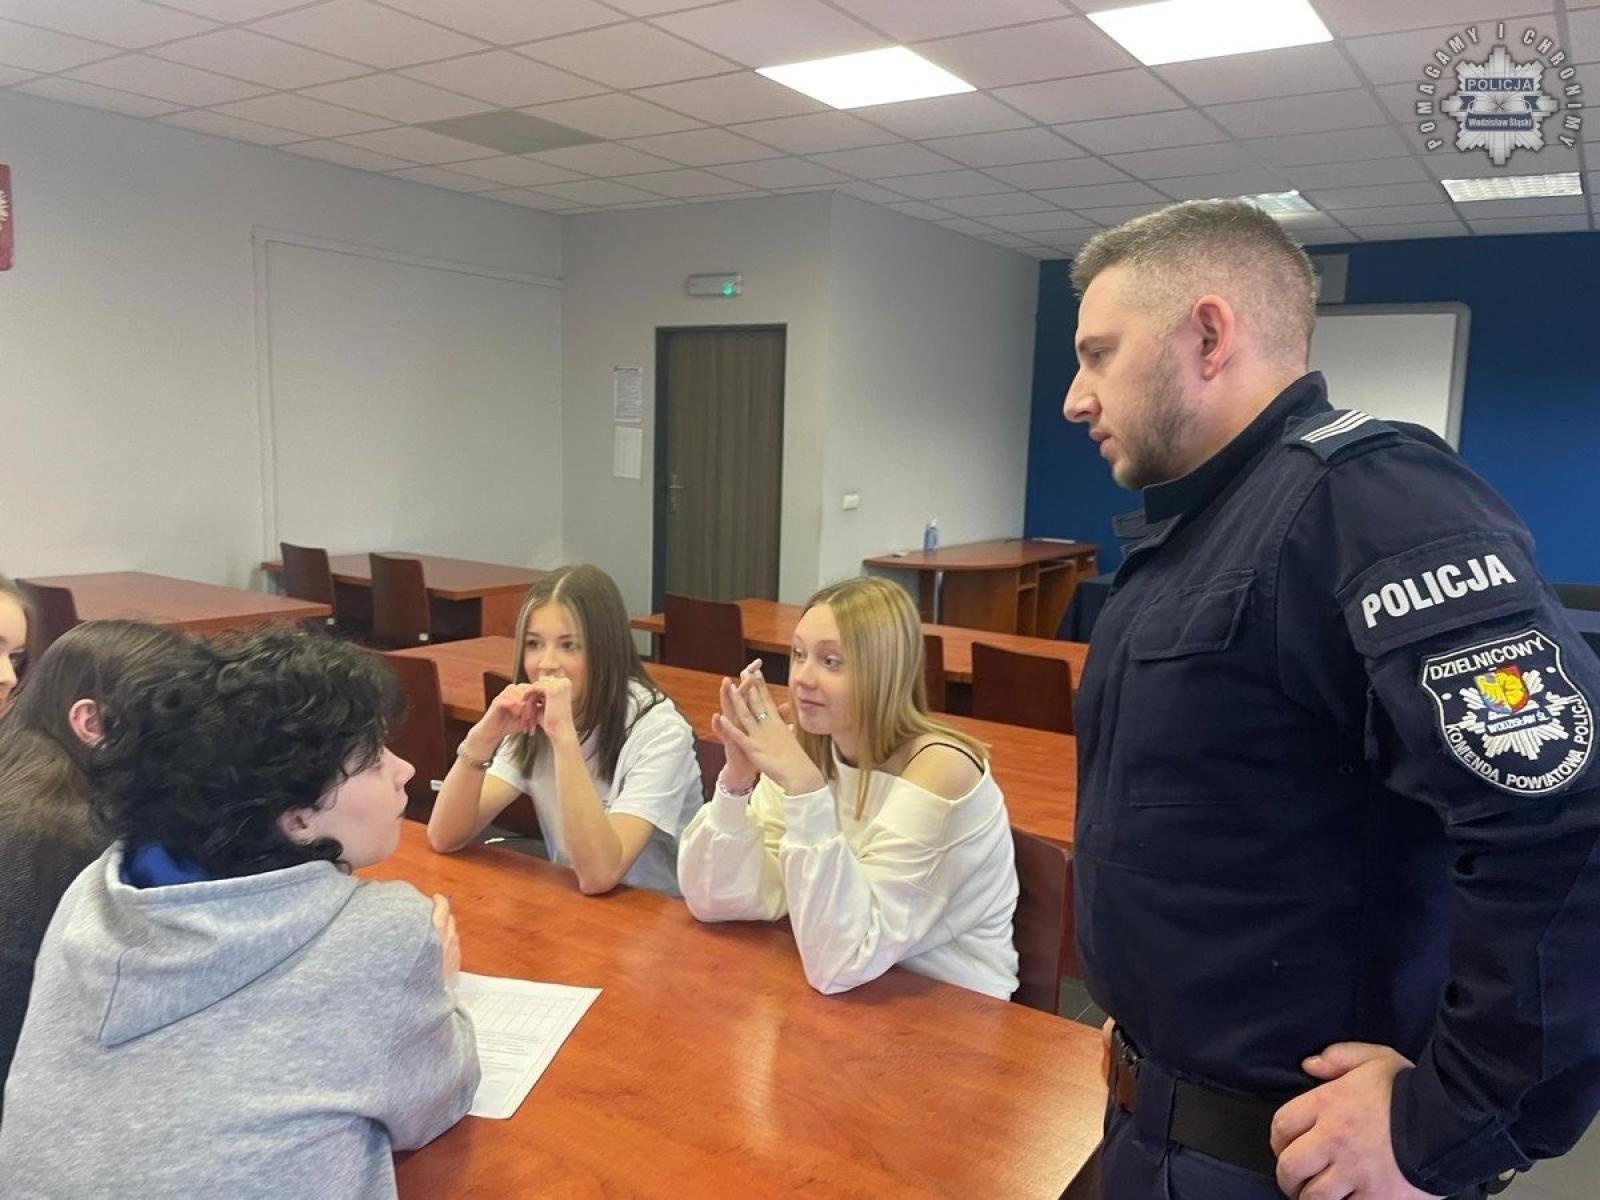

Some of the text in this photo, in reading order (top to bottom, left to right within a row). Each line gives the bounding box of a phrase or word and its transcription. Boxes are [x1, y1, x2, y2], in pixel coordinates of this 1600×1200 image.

[1361, 554, 1517, 628] POLICJA
[1430, 637, 1545, 681] DZIELNICOWY
[1445, 724, 1500, 782] KOMENDA
[1506, 750, 1585, 789] POWIATOWA
